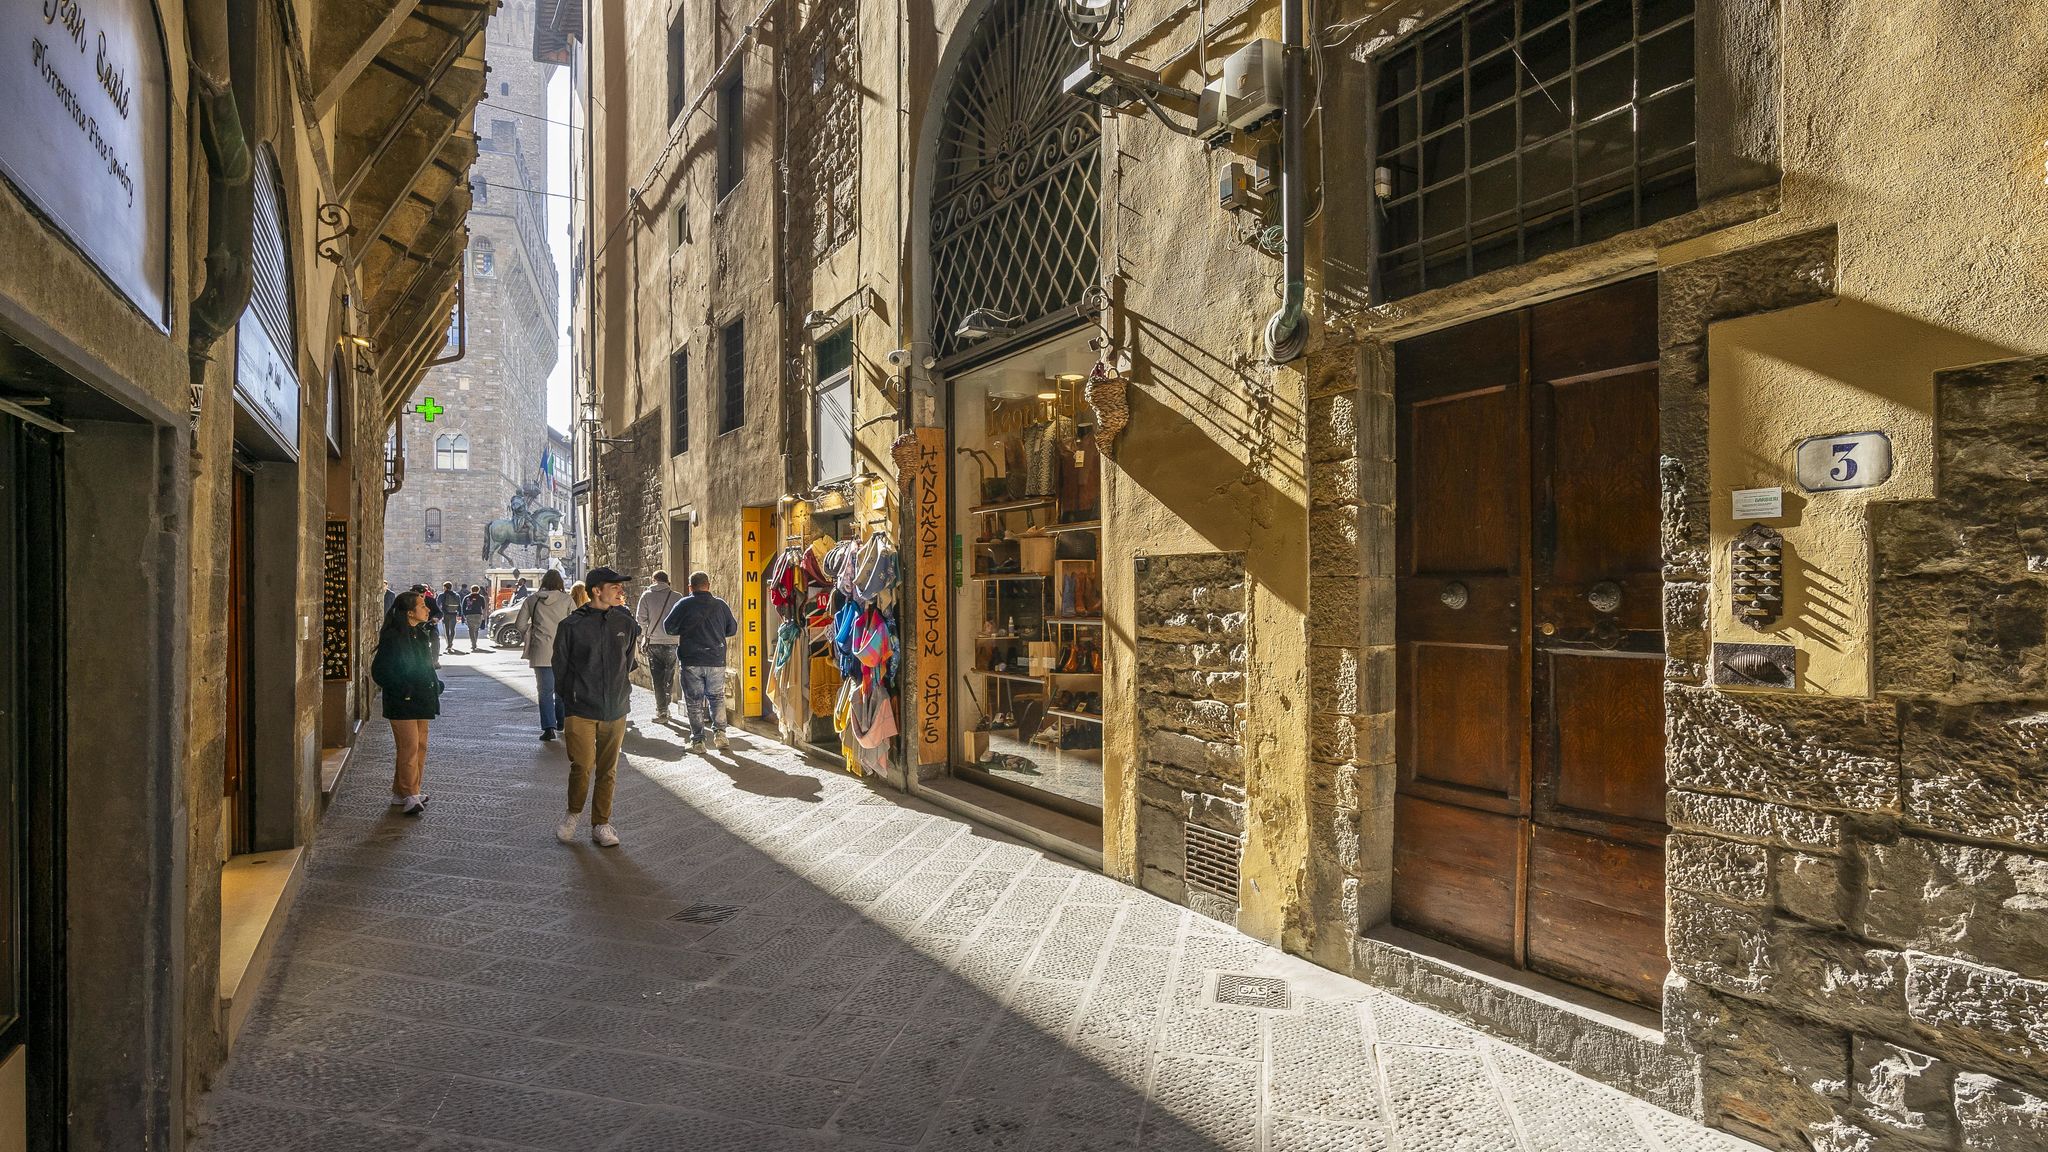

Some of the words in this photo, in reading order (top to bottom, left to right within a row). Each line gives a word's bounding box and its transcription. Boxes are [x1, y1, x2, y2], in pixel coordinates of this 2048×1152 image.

[32, 37, 87, 131] Florentine
[88, 117, 107, 161] Fine
[107, 146, 134, 208] Jewelry
[1830, 442, 1859, 482] 3
[920, 445, 941, 558] HANDMADE
[746, 530, 758, 583] ATM
[818, 595, 827, 606] 10
[922, 574, 943, 657] CUSTOM
[747, 598, 758, 677] HERE
[923, 674, 942, 744] SHOES
[1239, 985, 1267, 996] GAS
